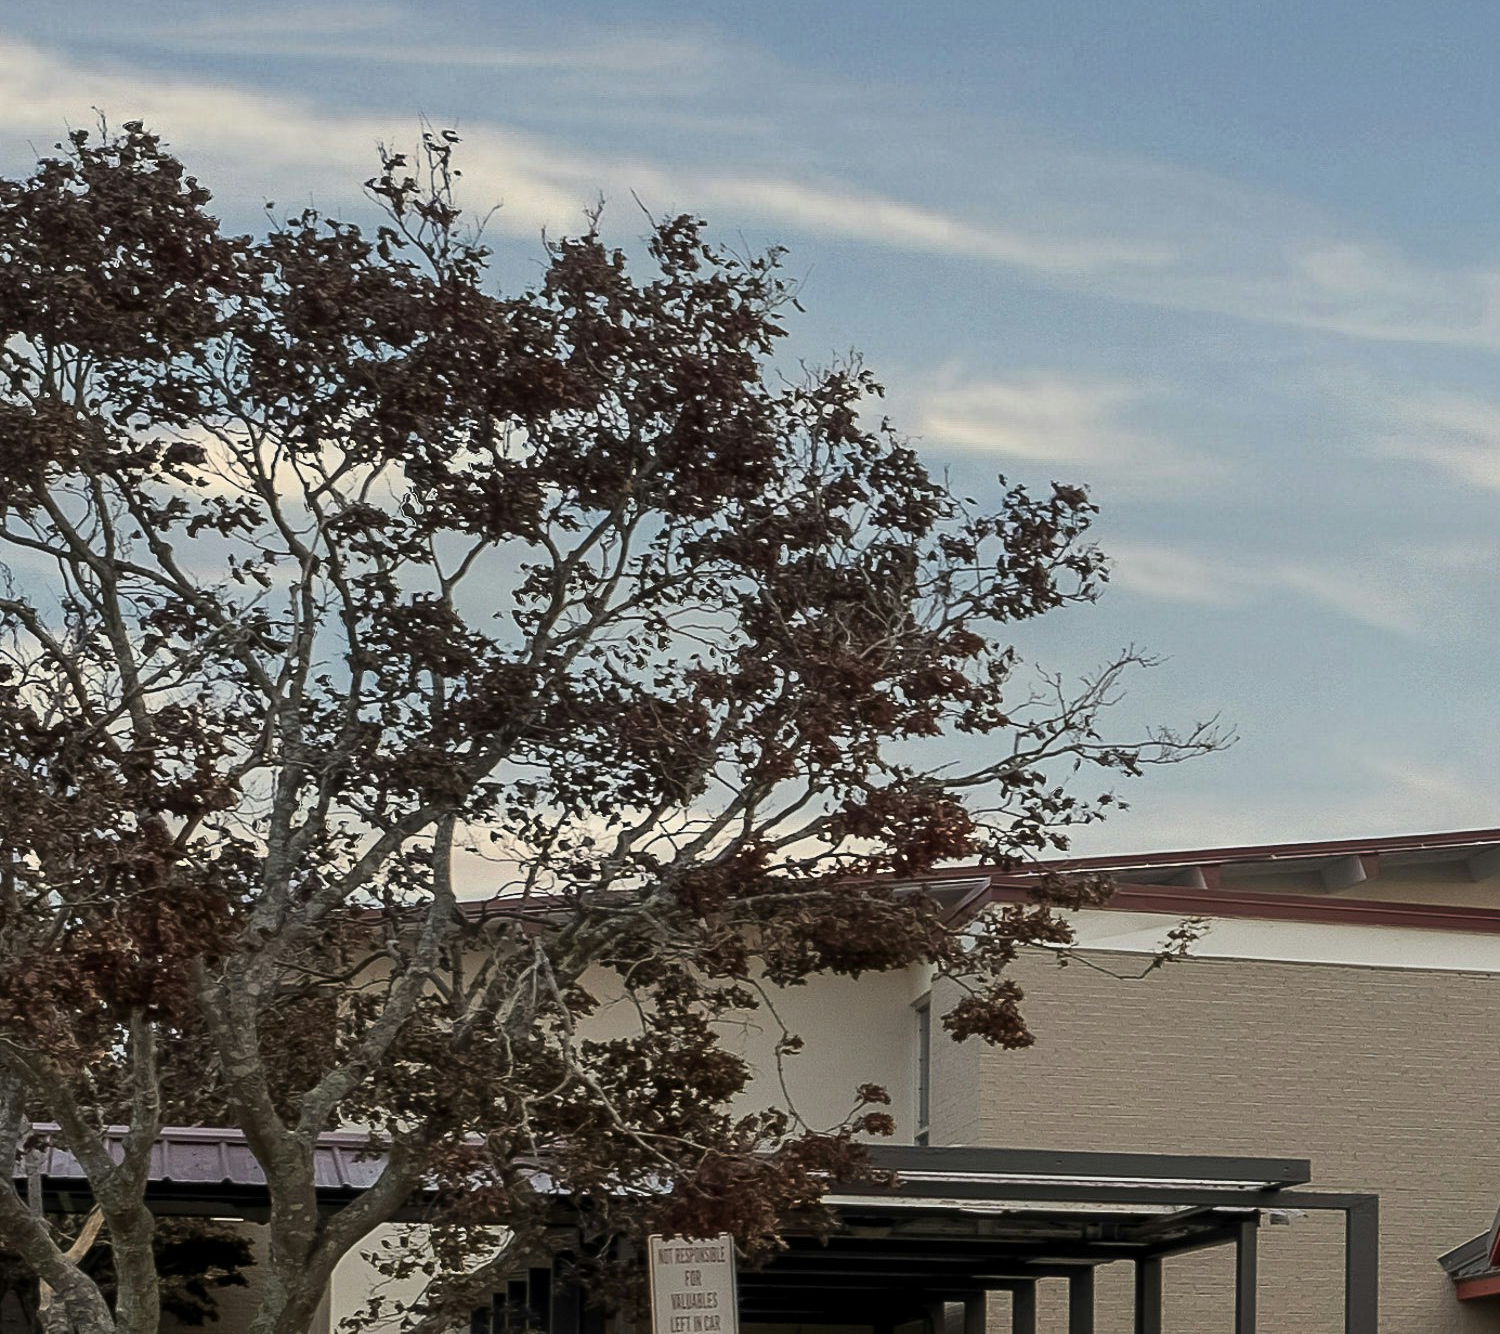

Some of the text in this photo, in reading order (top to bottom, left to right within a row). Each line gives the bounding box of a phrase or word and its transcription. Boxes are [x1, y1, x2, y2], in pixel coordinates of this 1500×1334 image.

[658, 1246, 726, 1264] NOT RESPONSIBLE
[685, 1270, 702, 1286] FOR
[671, 1292, 718, 1310] VALUABLES
[670, 1314, 721, 1333] LEFT IN CAR
